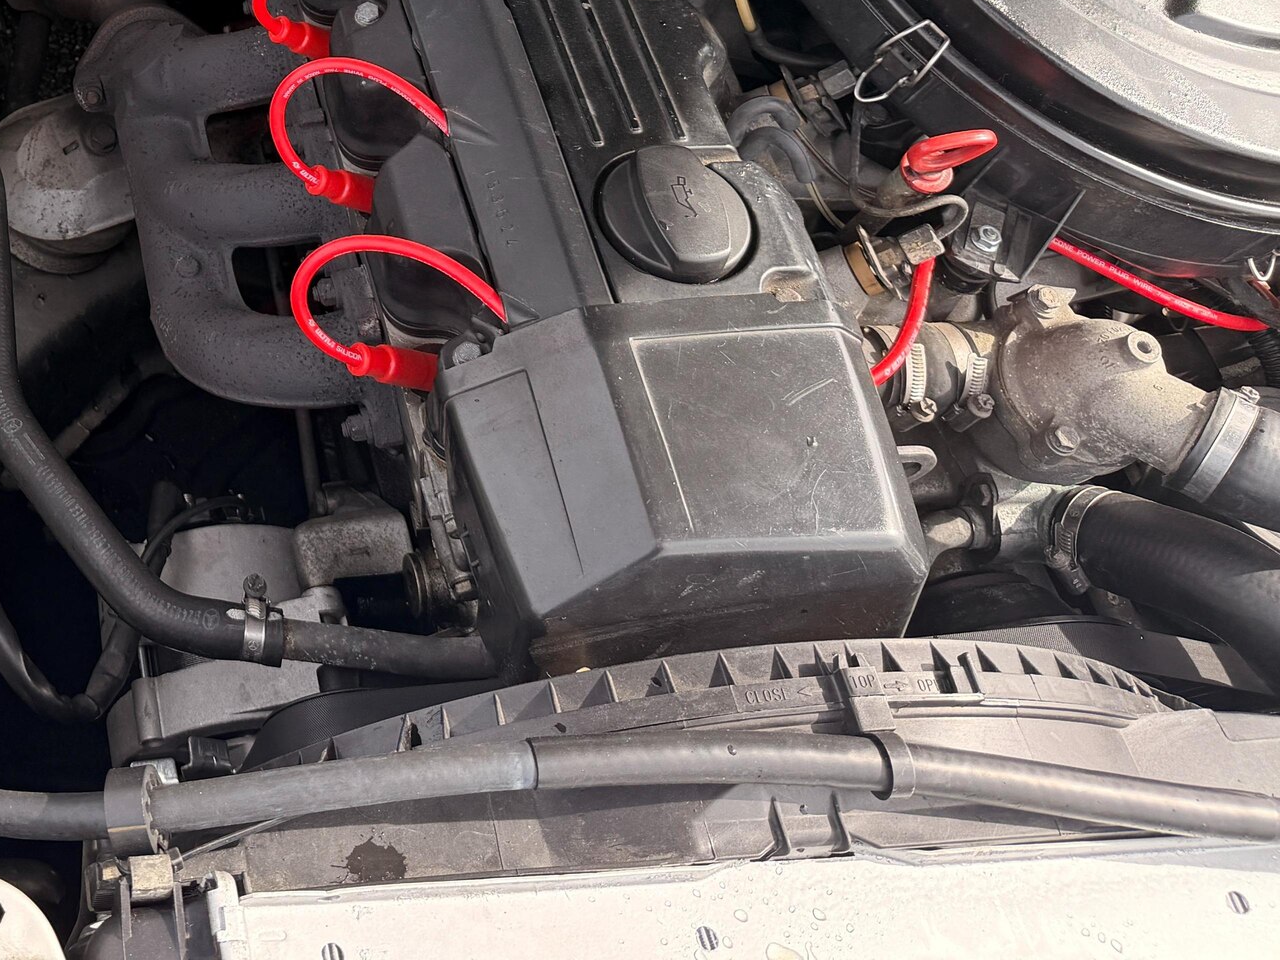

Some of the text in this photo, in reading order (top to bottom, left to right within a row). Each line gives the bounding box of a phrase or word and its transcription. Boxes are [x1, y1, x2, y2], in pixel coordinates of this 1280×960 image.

[1052, 238, 1074, 255] CONE
[1076, 250, 1107, 270] POWER
[1108, 265, 1130, 280] PLUG
[1132, 276, 1154, 292] WIRE
[336, 345, 363, 362] SILICON
[849, 674, 876, 690] TOP
[917, 678, 940, 692] OP
[745, 686, 789, 705] CLOSE
